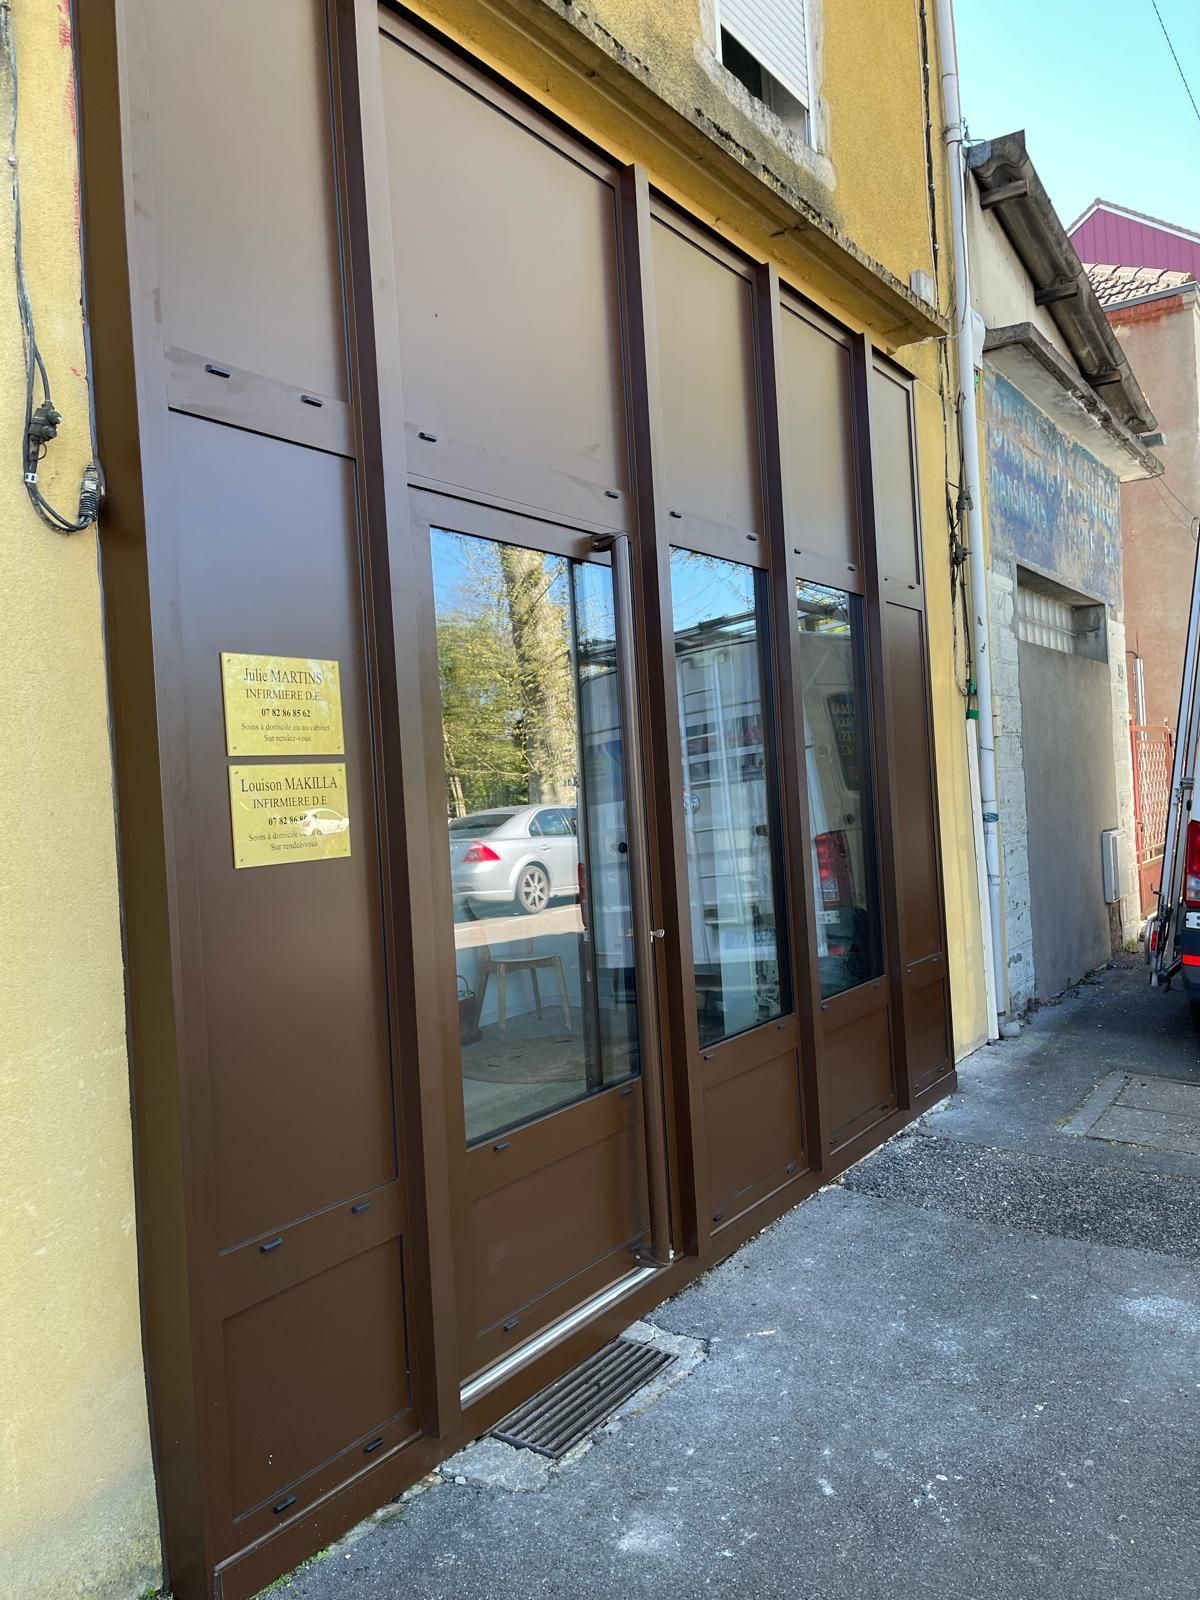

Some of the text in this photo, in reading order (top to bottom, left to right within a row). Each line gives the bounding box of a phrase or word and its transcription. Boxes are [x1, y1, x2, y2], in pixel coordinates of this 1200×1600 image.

[243, 667, 323, 685] Julie MARTINS
[245, 688, 304, 700] INFIRMIERE
[261, 708, 311, 718] 07 82 86 85 62
[241, 776, 338, 793] Louison MAKILLA
[253, 796, 310, 809] INFIRMIERE
[268, 818, 277, 826] 07
[278, 817, 287, 825] 82
